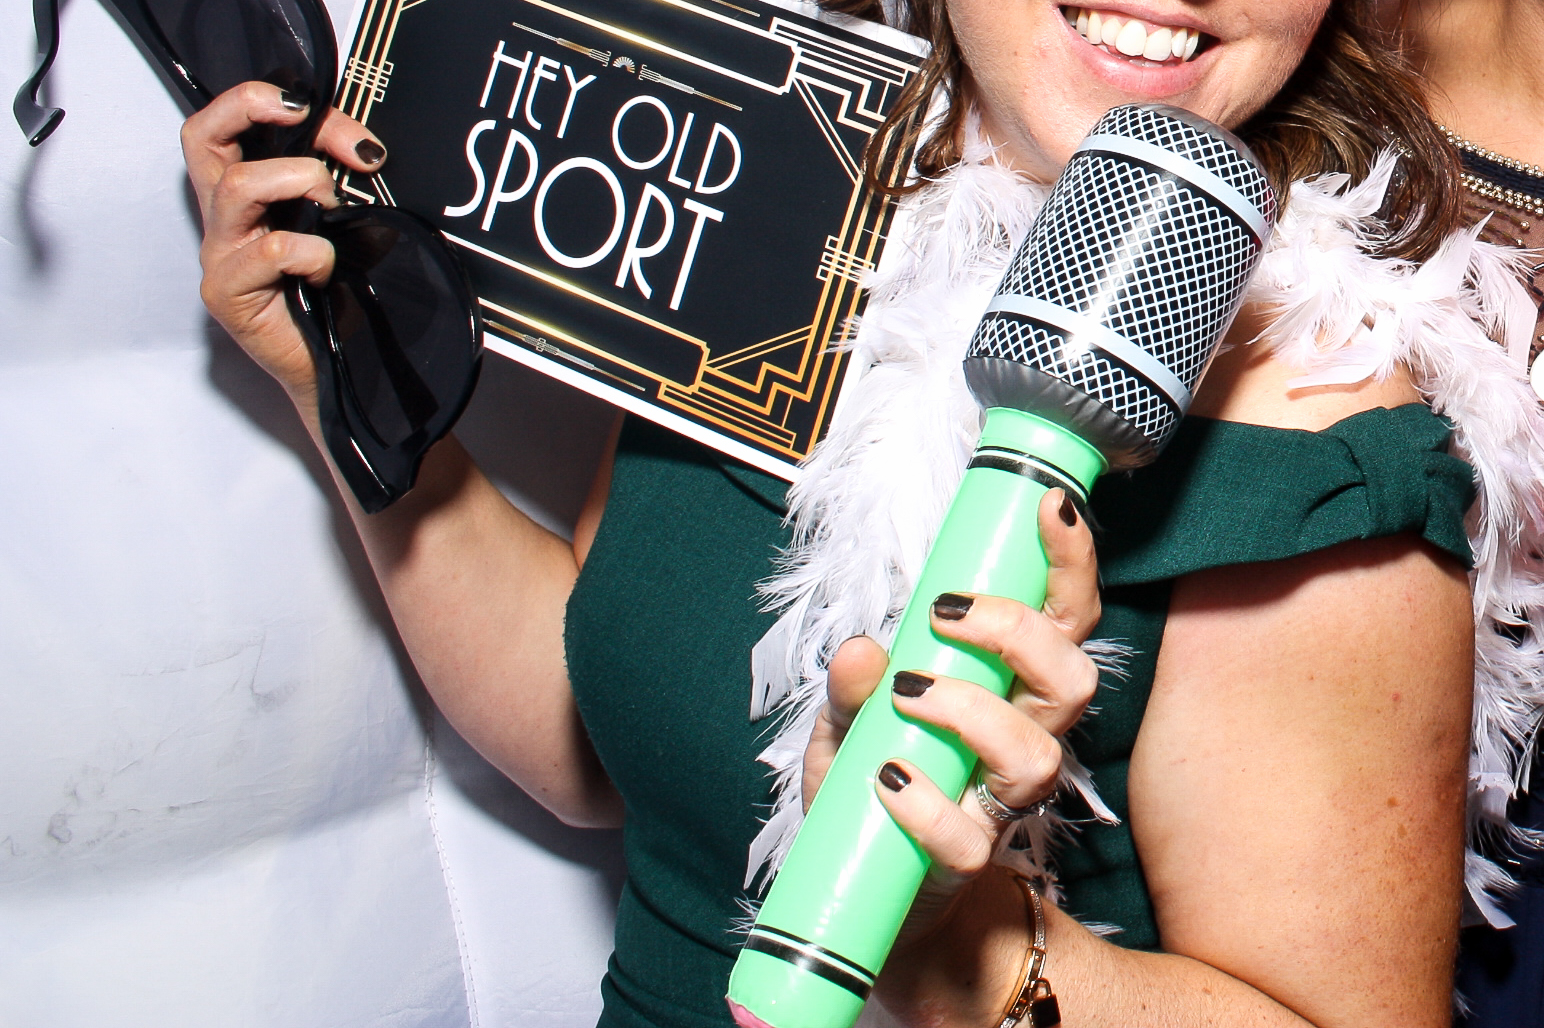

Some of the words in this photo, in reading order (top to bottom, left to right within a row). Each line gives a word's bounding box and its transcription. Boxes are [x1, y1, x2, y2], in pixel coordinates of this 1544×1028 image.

[479, 40, 597, 139] HEY
[611, 95, 742, 195] OLD
[443, 119, 725, 310] SPORT
